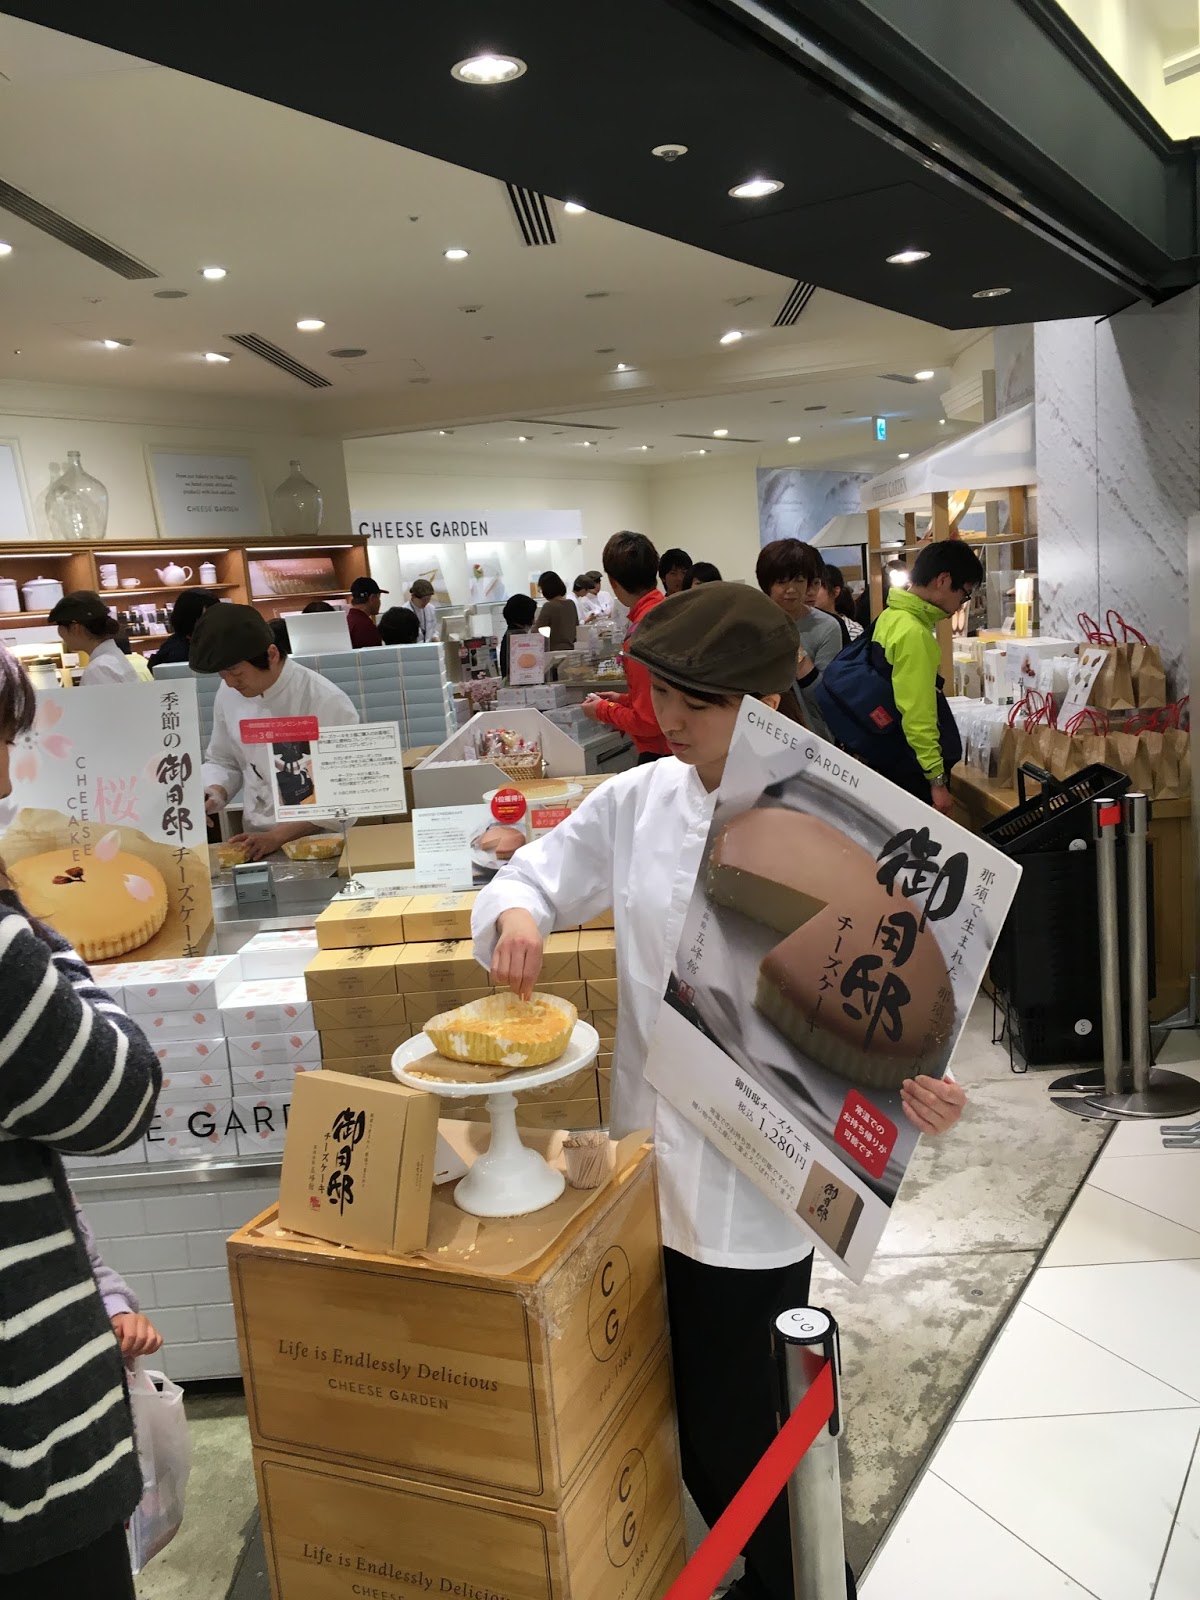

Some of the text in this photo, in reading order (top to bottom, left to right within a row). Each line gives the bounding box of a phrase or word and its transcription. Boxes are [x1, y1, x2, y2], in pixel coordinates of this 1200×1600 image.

[359, 521, 489, 539] CHEESE GARDEN
[747, 711, 860, 789] CHEESE GARDEN
[75, 756, 92, 857] CHEESE
[93, 775, 142, 825] 桜
[66, 797, 82, 862] CAKE
[947, 868, 996, 982] 那須で生まれた
[805, 916, 853, 1033] チーズケーキ
[188, 1103, 291, 1138] GAR
[735, 1077, 811, 1153] 御用邸チーズケーキ
[843, 1111, 888, 1154] お持ち帰りが
[854, 1104, 885, 1135] 常温での
[318, 1131, 332, 1195] チーズケーキ
[844, 1128, 874, 1164] 可能です。
[279, 1340, 498, 1392] Life is Endlessly Delicious
[328, 1378, 449, 1410] CHEESE GARDEN
[304, 1543, 333, 1565] Life
[338, 1552, 351, 1568] is
[356, 1556, 433, 1592] Endlessly
